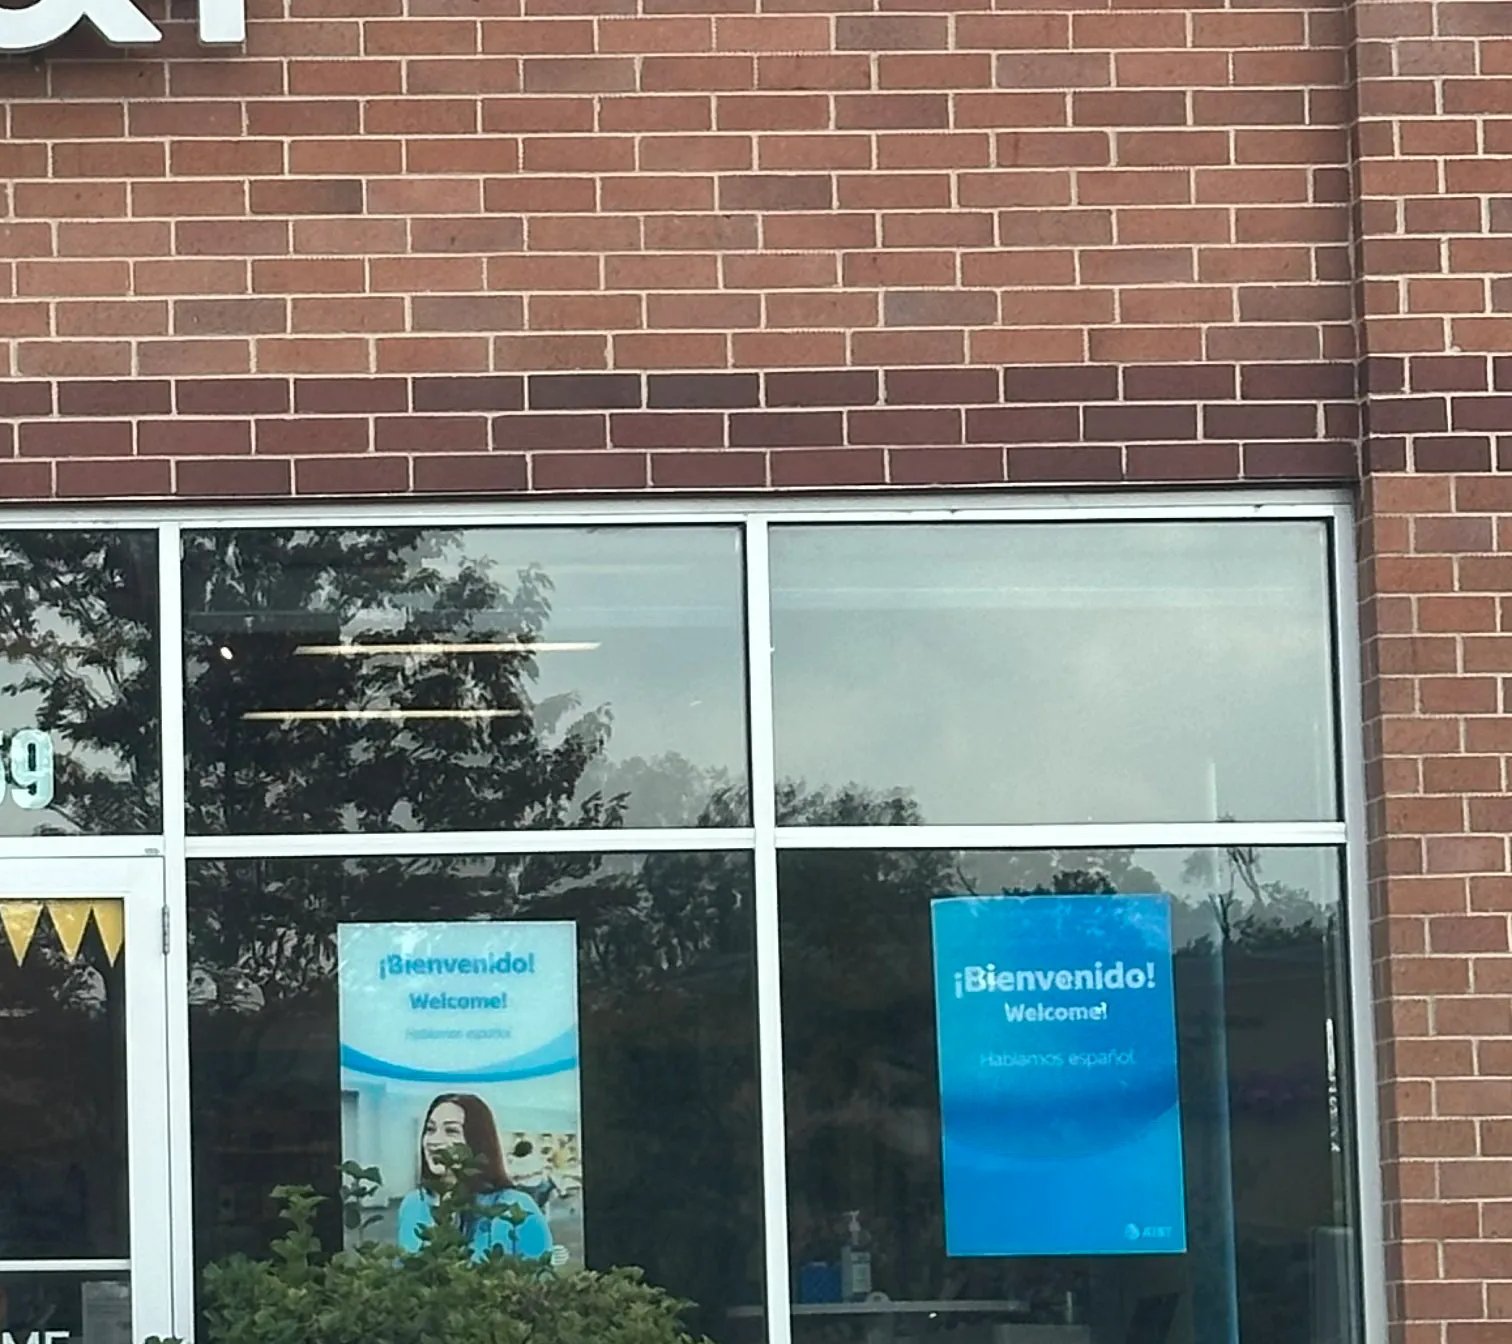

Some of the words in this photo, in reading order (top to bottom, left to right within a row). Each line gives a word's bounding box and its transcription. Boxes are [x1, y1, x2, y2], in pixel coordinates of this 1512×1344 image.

[380, 952, 535, 979] ¡Bienvenido!
[954, 961, 1156, 998] ¡Bienvenido!
[409, 992, 508, 1010] Welcome!
[1004, 1002, 1108, 1022] Welcome!
